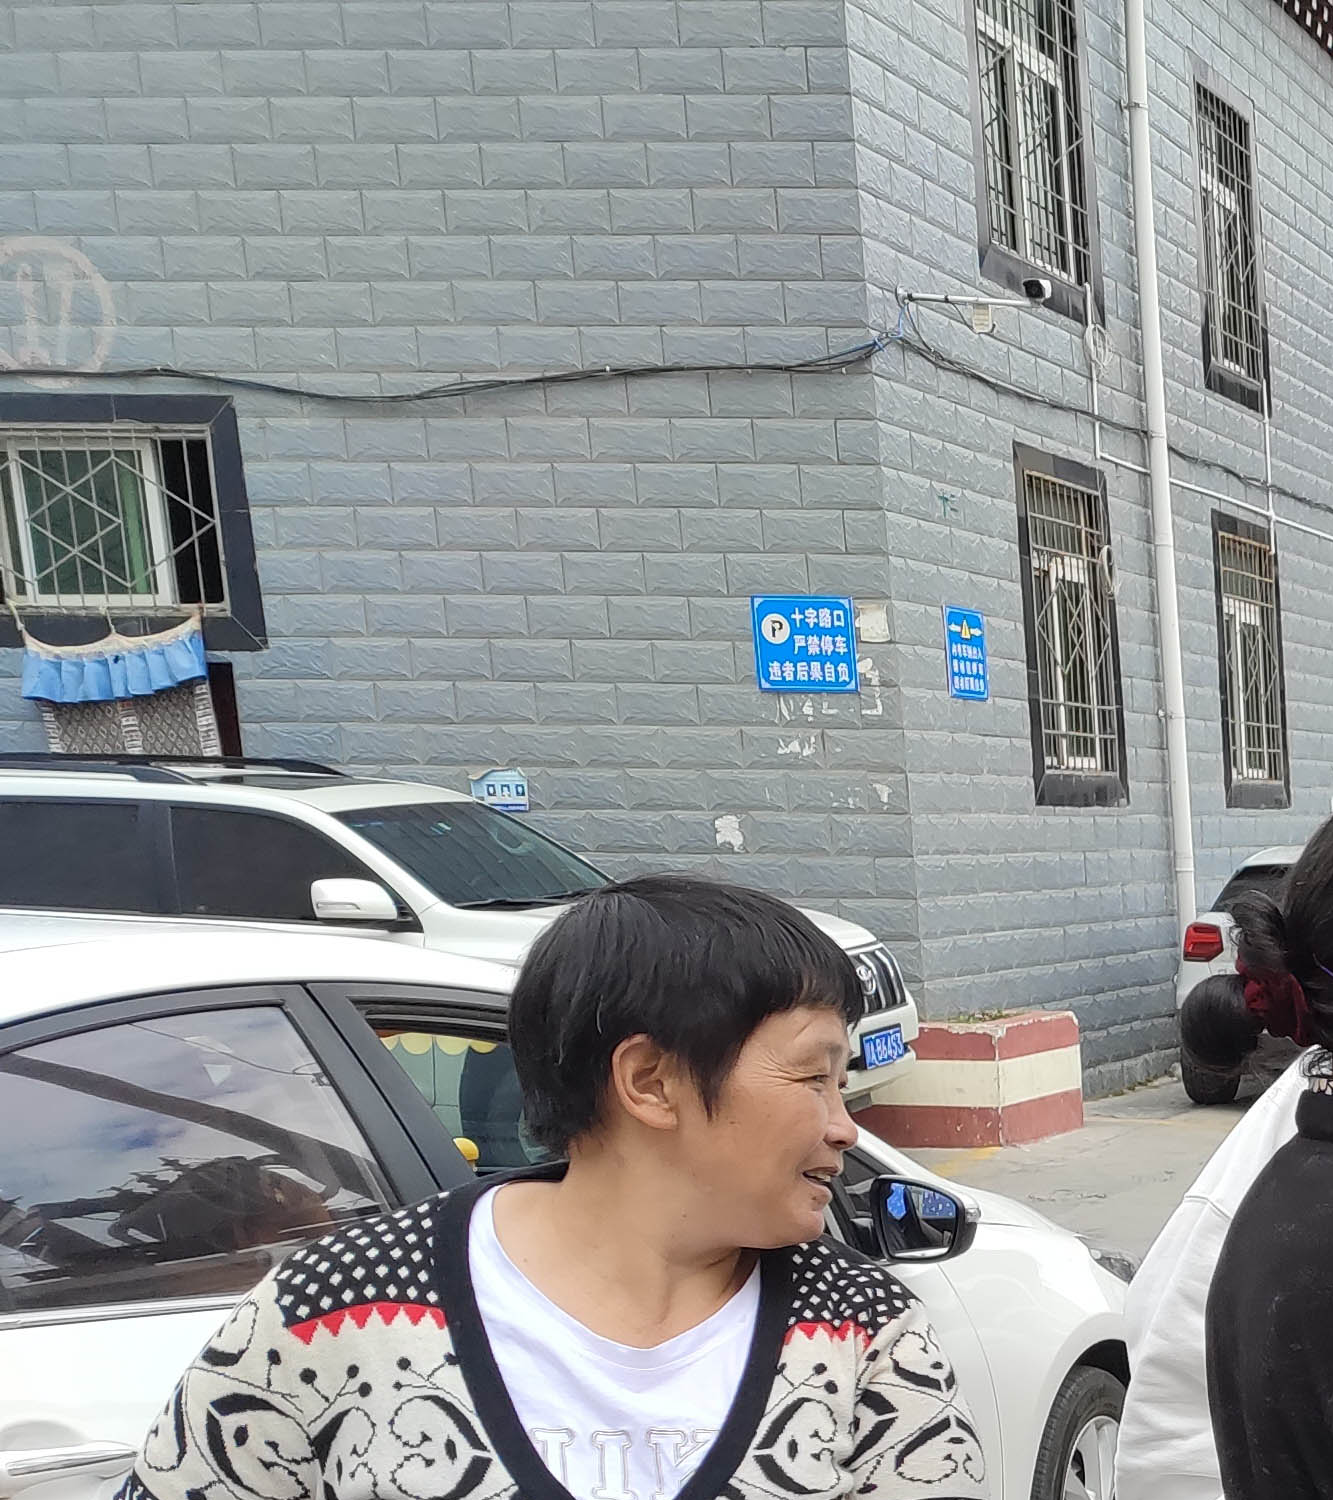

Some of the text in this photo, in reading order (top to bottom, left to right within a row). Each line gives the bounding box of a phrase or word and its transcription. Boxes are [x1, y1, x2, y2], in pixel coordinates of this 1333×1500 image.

[790, 607, 845, 628] 十字路口
[793, 634, 848, 656] 严禁停车
[768, 661, 850, 683] 违者后果自负
